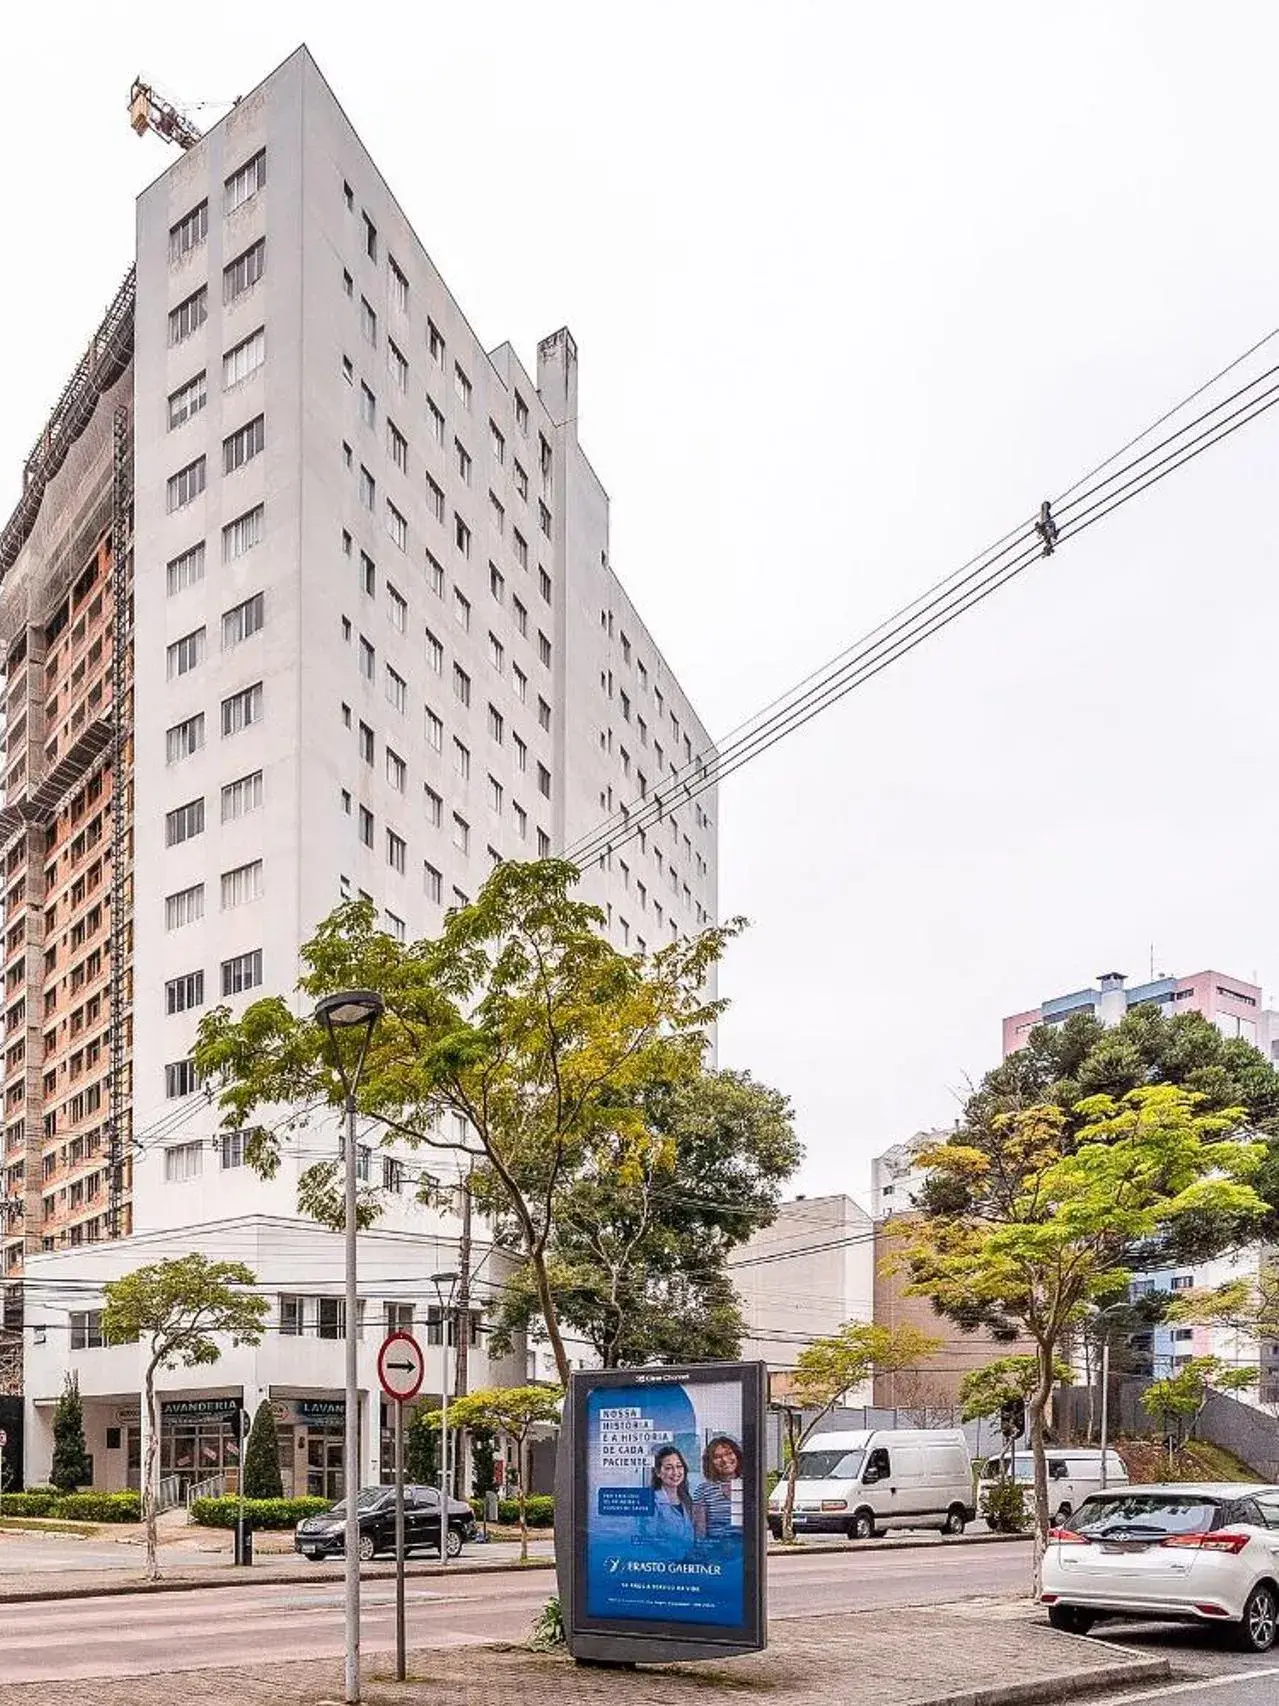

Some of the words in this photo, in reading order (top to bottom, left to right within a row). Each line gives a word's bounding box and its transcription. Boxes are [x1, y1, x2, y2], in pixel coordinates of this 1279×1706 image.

[163, 1400, 237, 1413] AVANDERIA
[304, 1403, 345, 1413] LAVAN
[603, 1408, 637, 1418] NOSSA
[603, 1446, 615, 1454] DE
[618, 1446, 644, 1454] CADA
